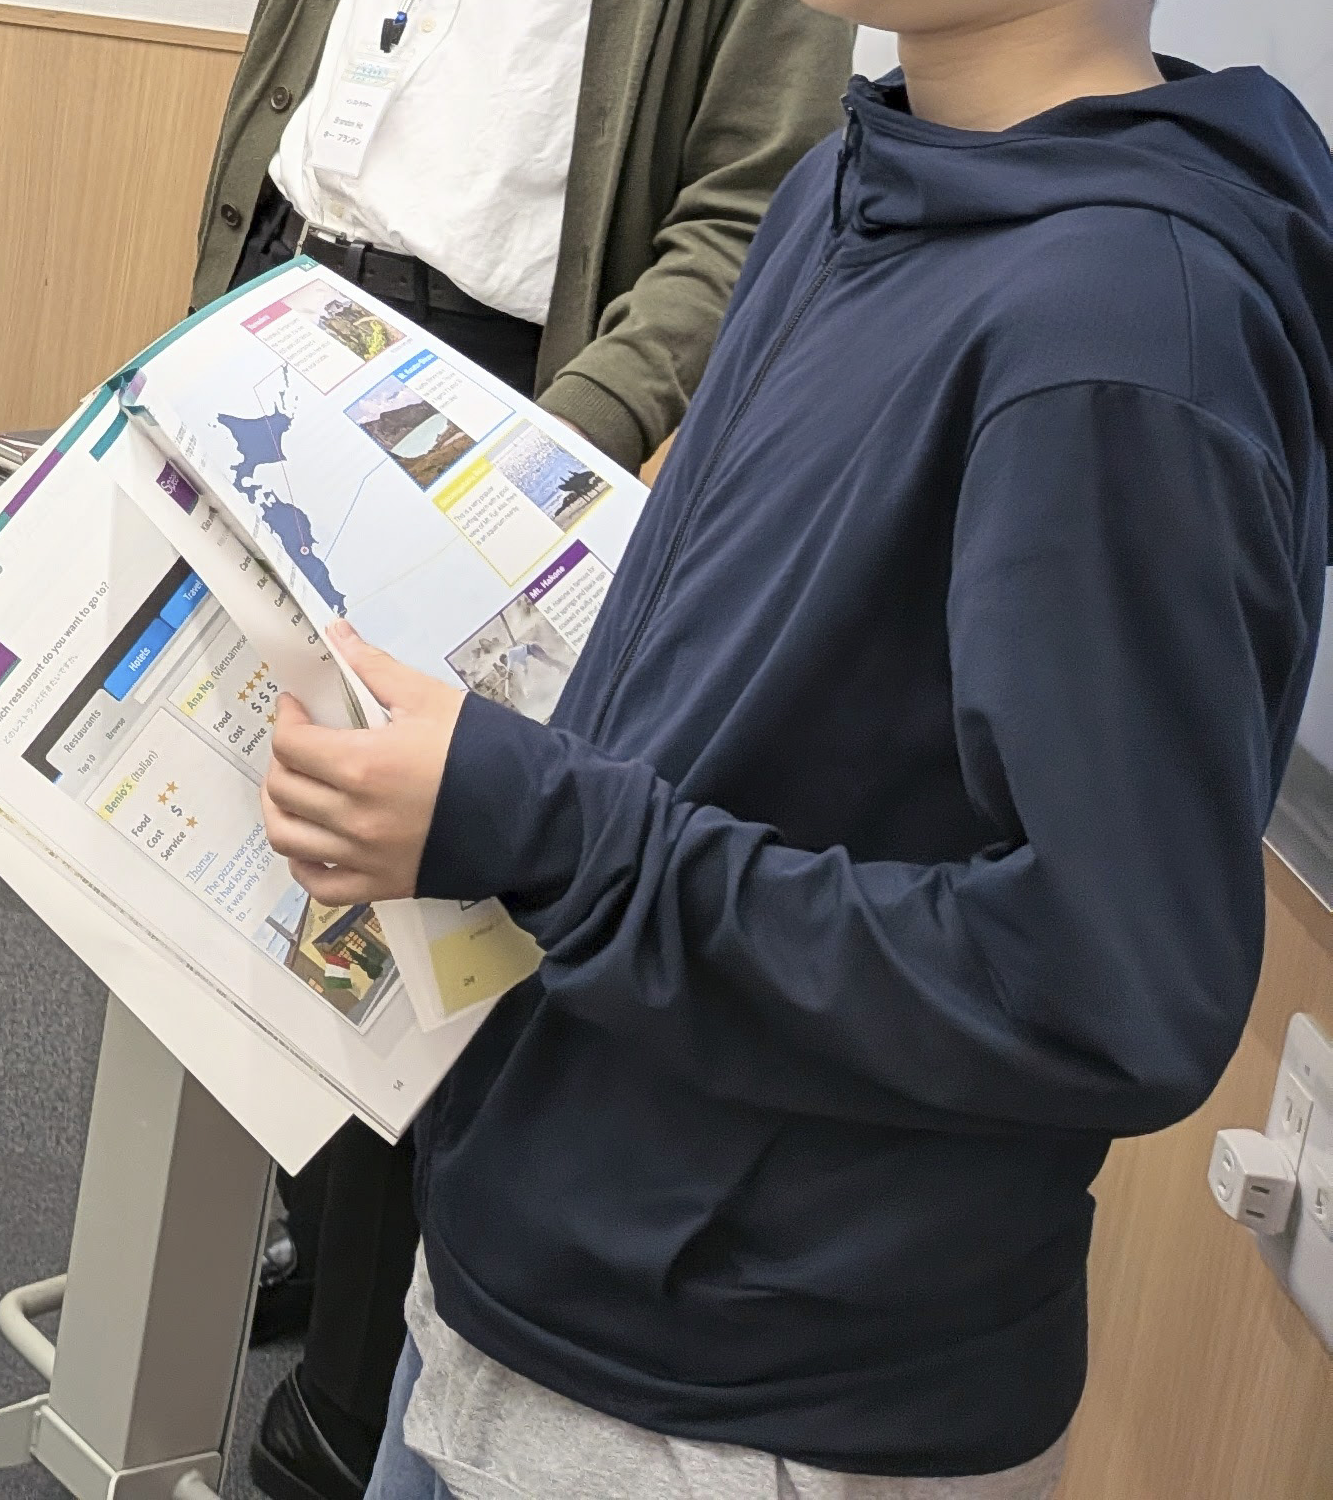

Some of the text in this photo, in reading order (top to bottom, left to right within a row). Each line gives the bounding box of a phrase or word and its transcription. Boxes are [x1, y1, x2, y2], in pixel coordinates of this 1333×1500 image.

[184, 580, 203, 600] Travel
[528, 563, 566, 599] Mt. Hakone
[9, 663, 45, 706] restaurant
[40, 650, 54, 665] do
[51, 637, 66, 655] you
[64, 617, 83, 637] want
[79, 608, 90, 617] to
[87, 595, 101, 610] go
[95, 582, 109, 596] to?
[127, 645, 152, 673] Hotels
[187, 693, 203, 710] Ana
[199, 680, 214, 694] Ng
[64, 710, 101, 753] Restaurants
[106, 718, 125, 740] Browse
[213, 710, 232, 732] Food
[228, 725, 245, 743] Cost
[242, 728, 267, 756] Service
[77, 763, 90, 774] Top
[131, 750, 158, 782] (Italian)
[131, 814, 151, 837] Food
[147, 830, 164, 848] Cost
[161, 832, 186, 861] Service
[186, 850, 214, 881] Thomas
[204, 881, 220, 895] The
[216, 861, 235, 883] pizza
[233, 844, 248, 861] was
[218, 880, 235, 898] had
[231, 867, 247, 883] lots
[245, 855, 253, 867] of
[231, 890, 246, 906] was
[244, 872, 260, 891] only
